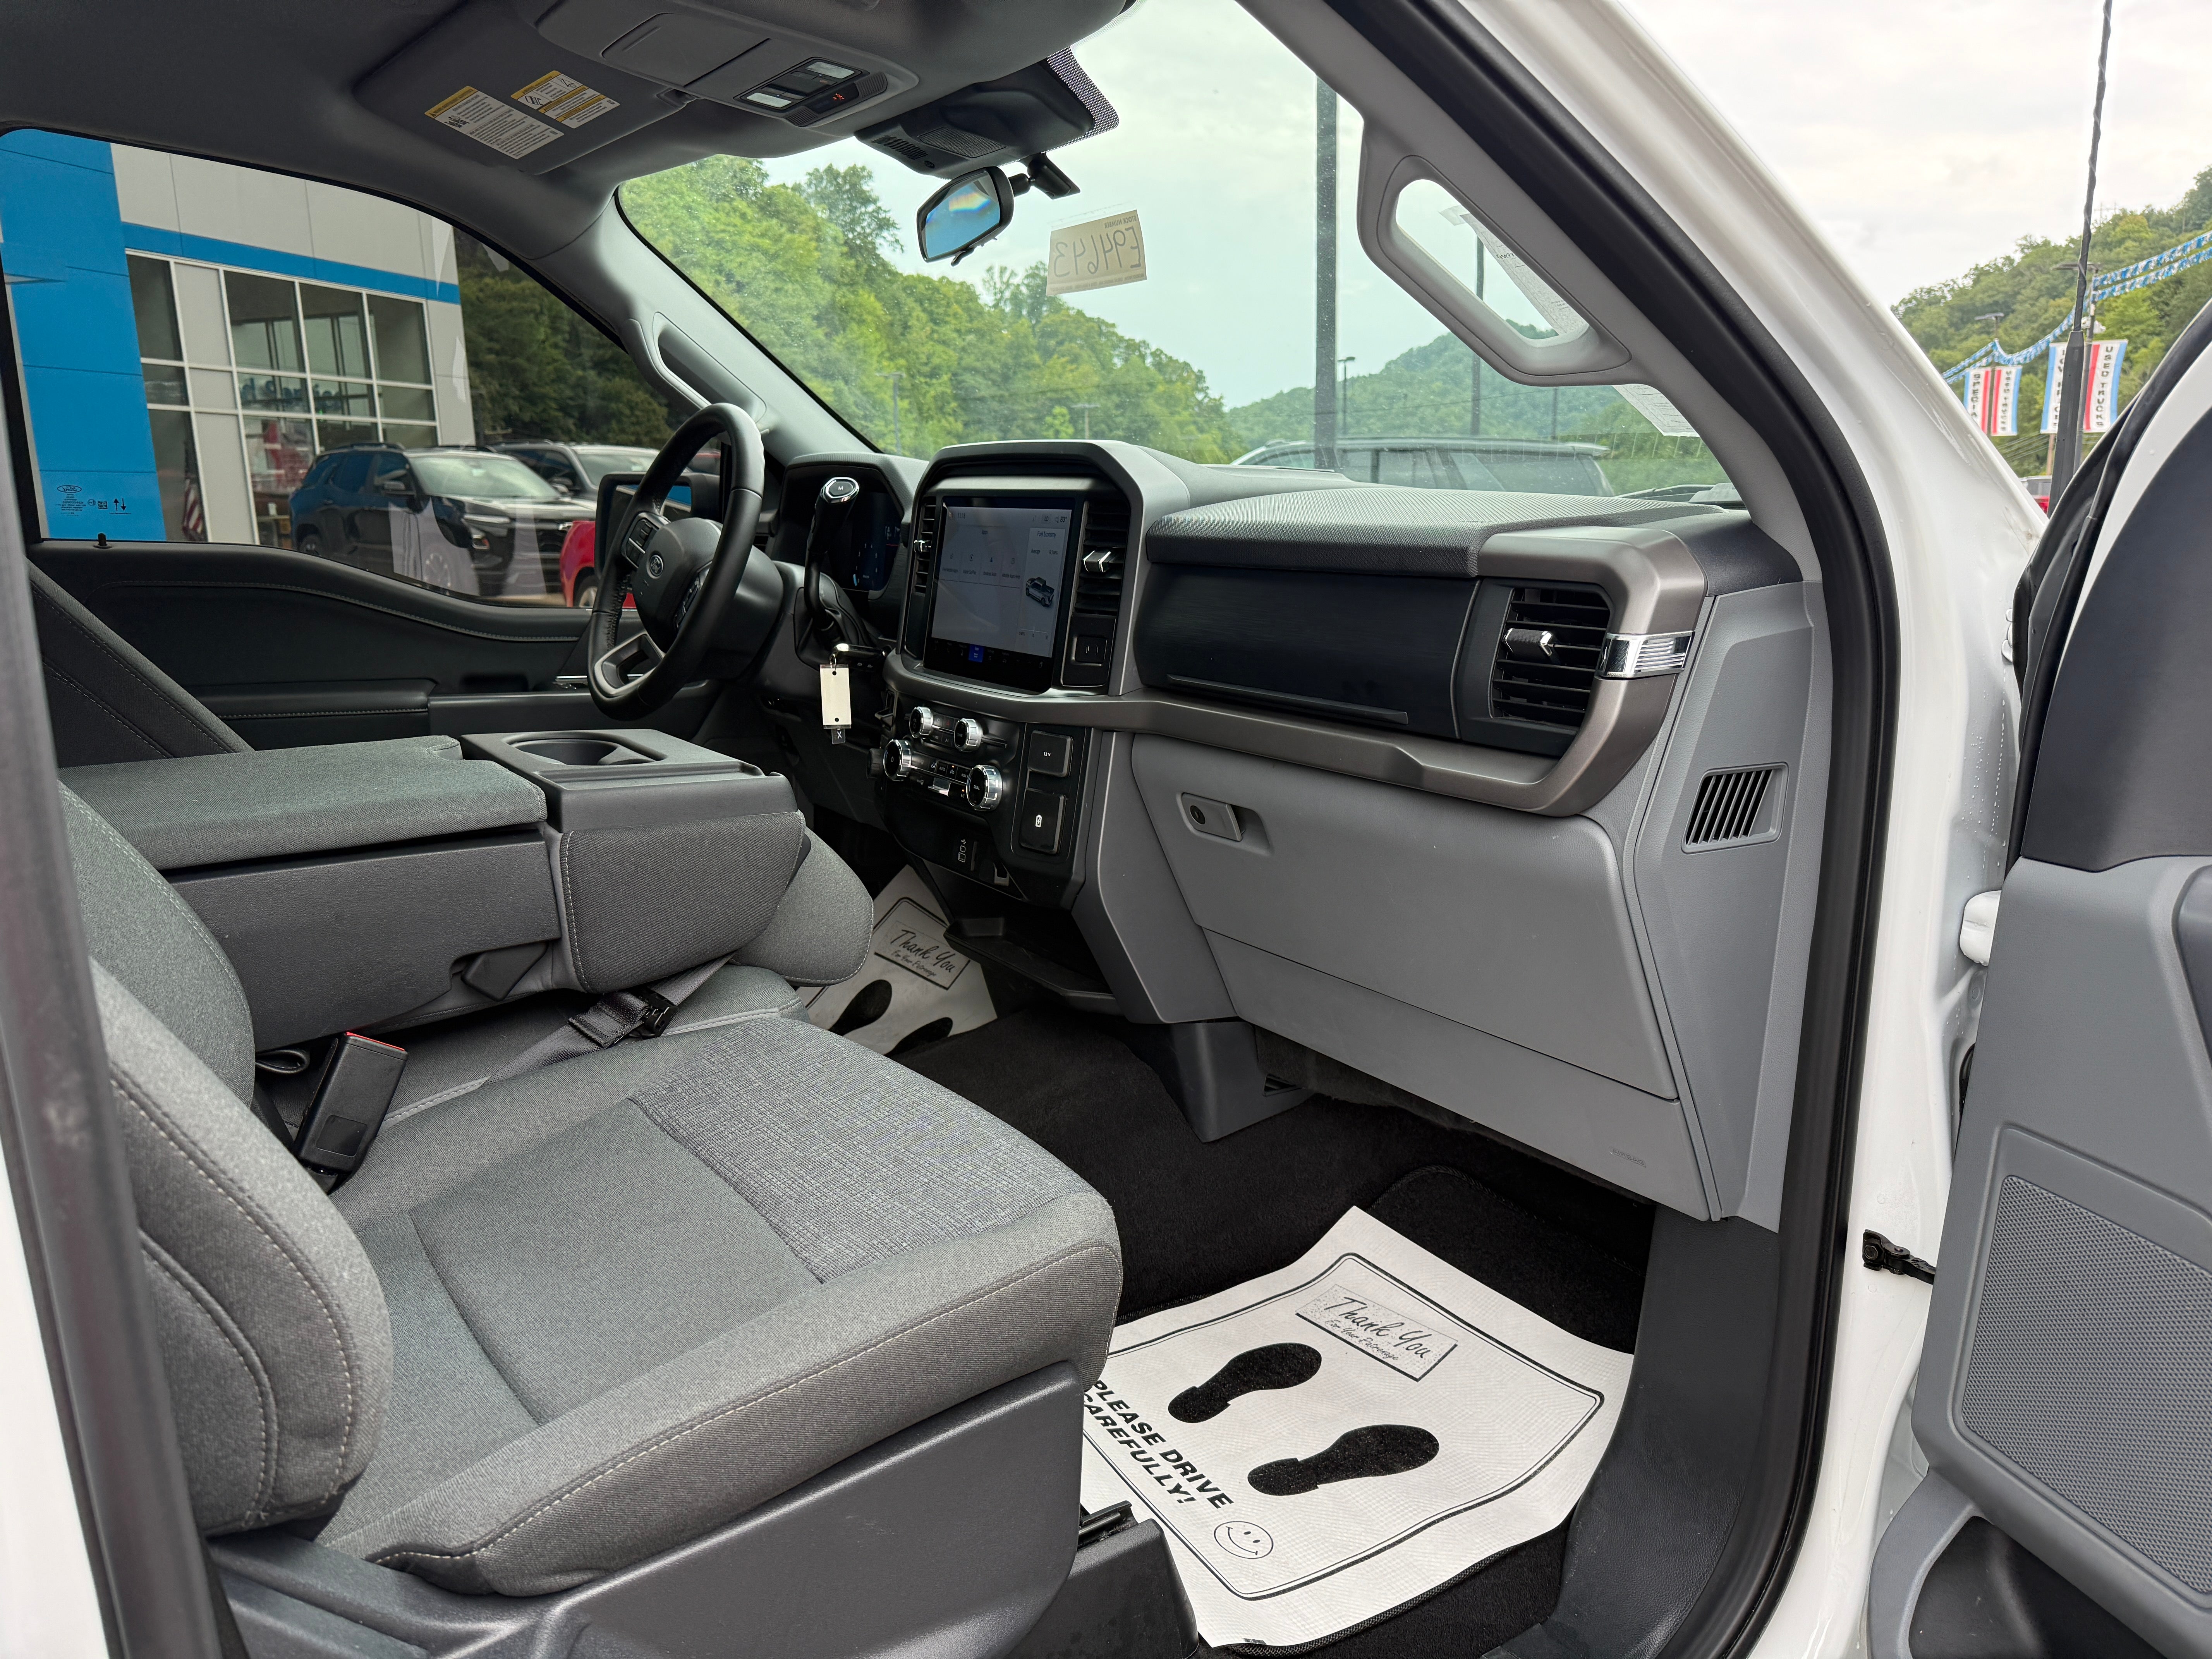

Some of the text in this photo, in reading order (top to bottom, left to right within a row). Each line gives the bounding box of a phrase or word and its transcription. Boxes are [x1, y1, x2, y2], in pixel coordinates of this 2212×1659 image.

[2096, 346, 2113, 426] USED TRUCKS
[890, 929, 956, 973] Thank You
[1612, 1148, 1645, 1166] AIRBAG
[1324, 1297, 1432, 1358] Thank You
[1358, 1337, 1399, 1360] Patronage
[1094, 1380, 1235, 1509] PLEASE DRIVE
